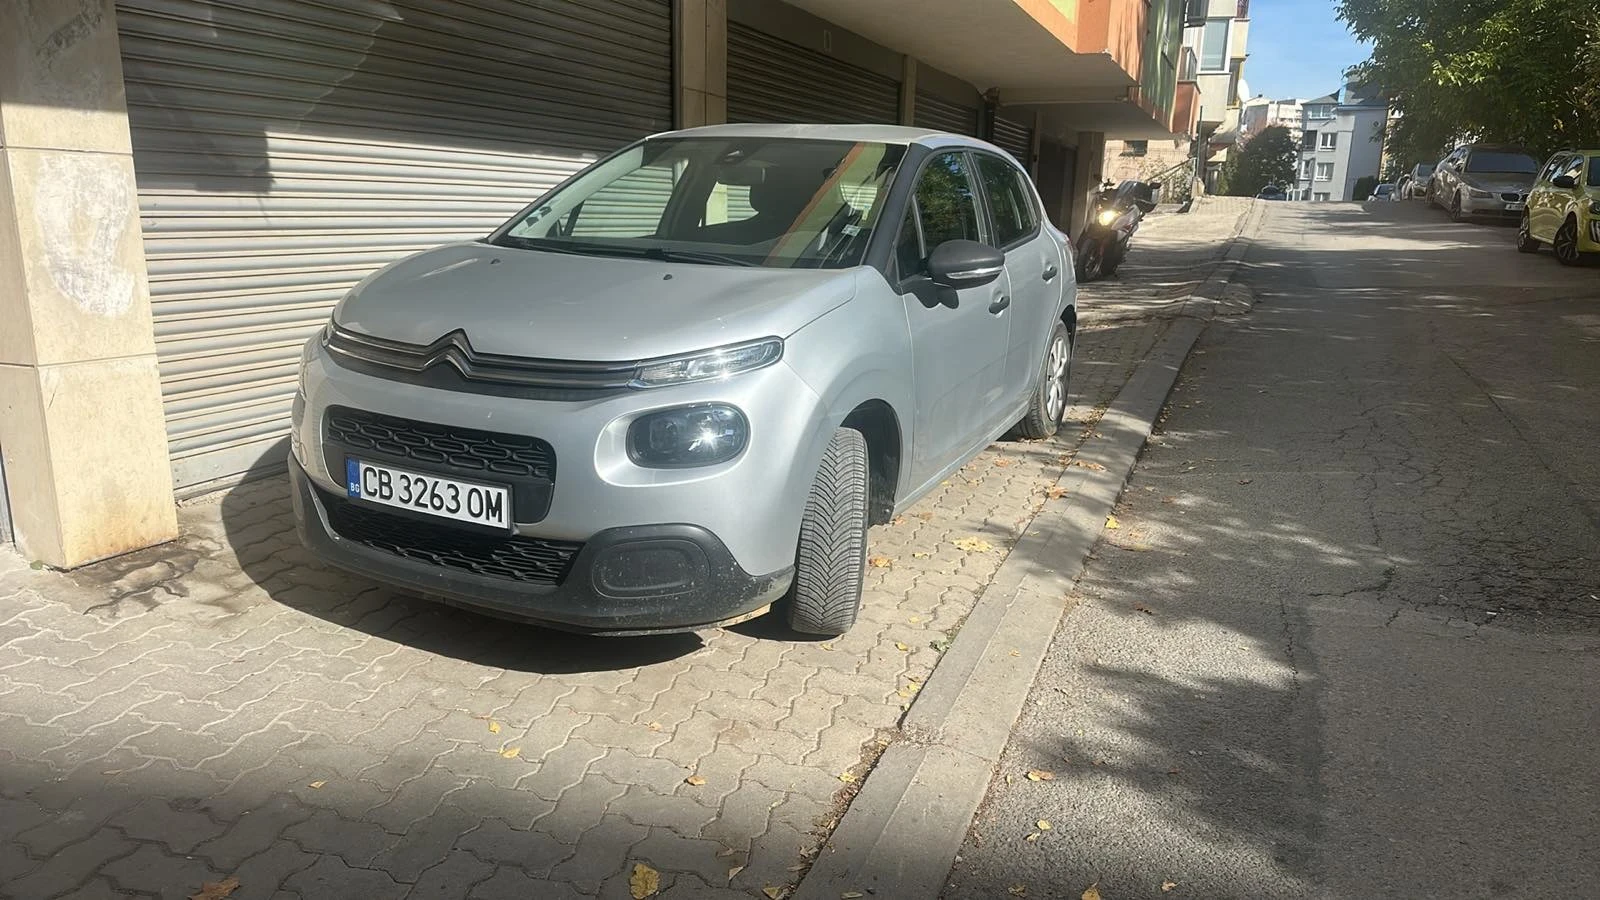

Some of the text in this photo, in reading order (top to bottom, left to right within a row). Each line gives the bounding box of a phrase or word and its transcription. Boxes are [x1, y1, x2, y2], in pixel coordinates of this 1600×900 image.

[350, 482, 360, 493] BG
[363, 466, 503, 523] CB 3263 OM
